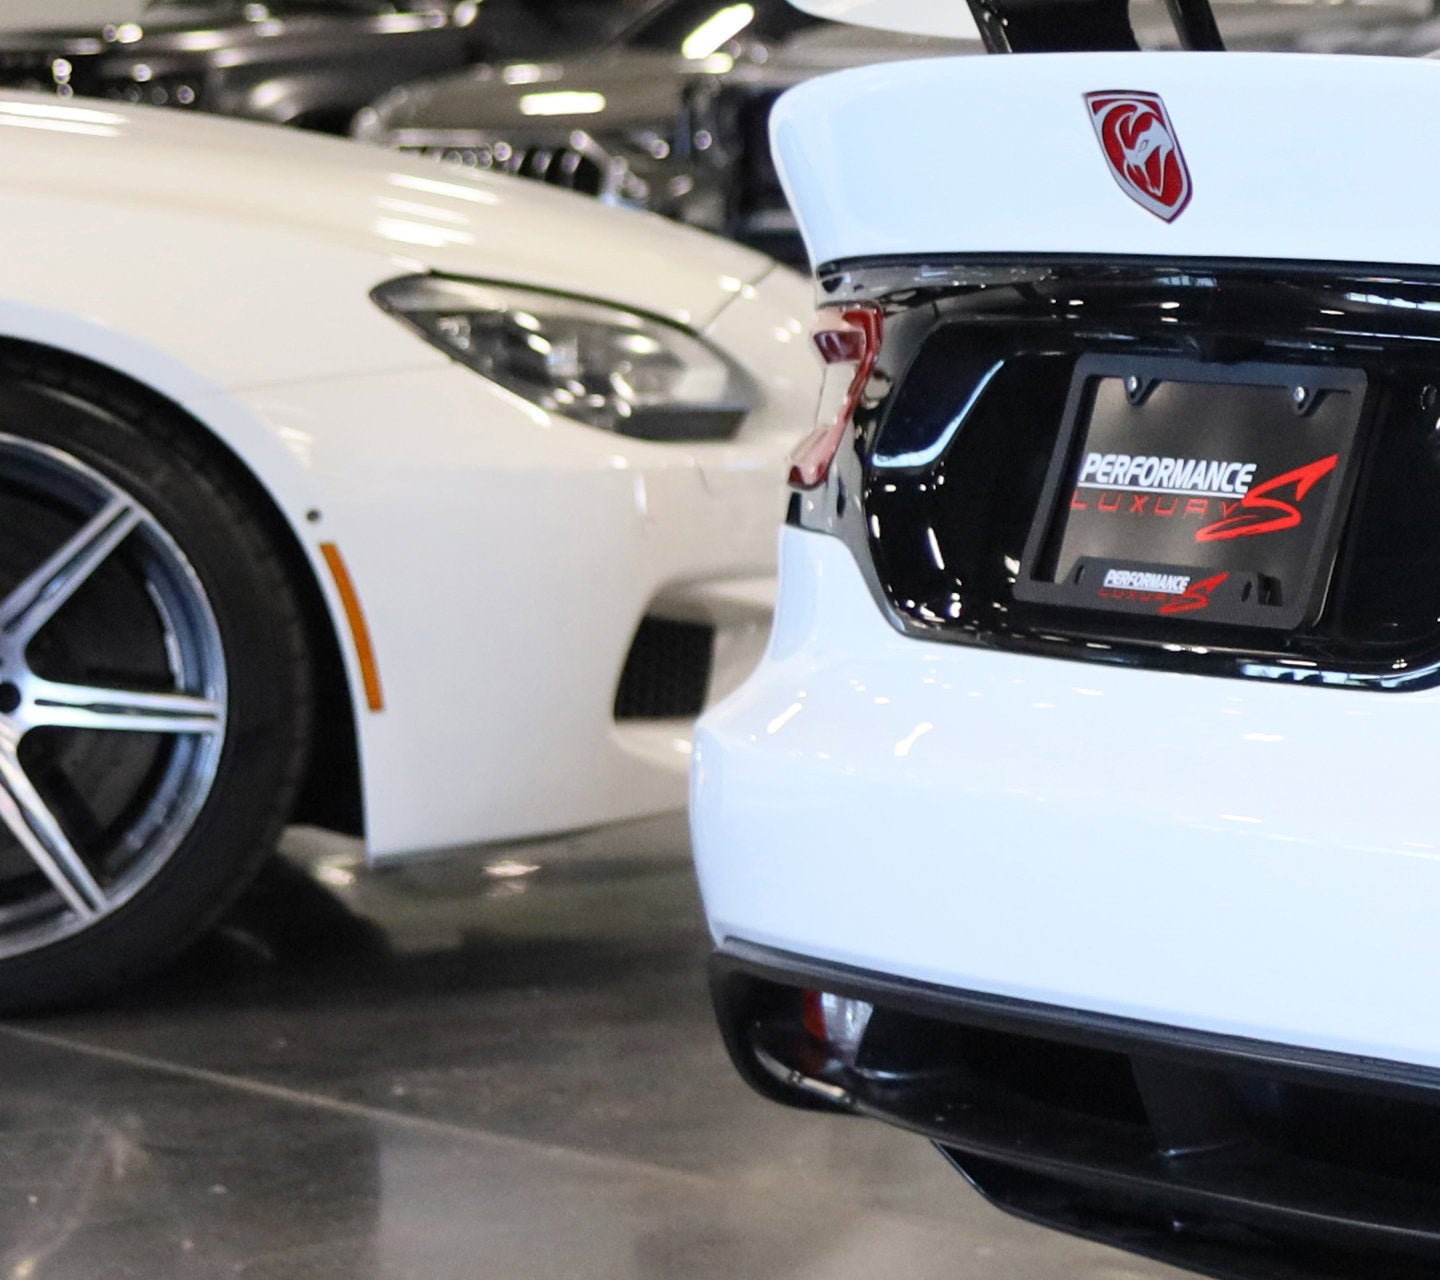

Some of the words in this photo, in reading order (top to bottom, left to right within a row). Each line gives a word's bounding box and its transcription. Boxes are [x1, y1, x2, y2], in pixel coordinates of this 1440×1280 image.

[1080, 452, 1257, 493] PERFORMANCE
[1069, 490, 1240, 519] LUXURY
[1103, 568, 1191, 593] PERFORMANCE
